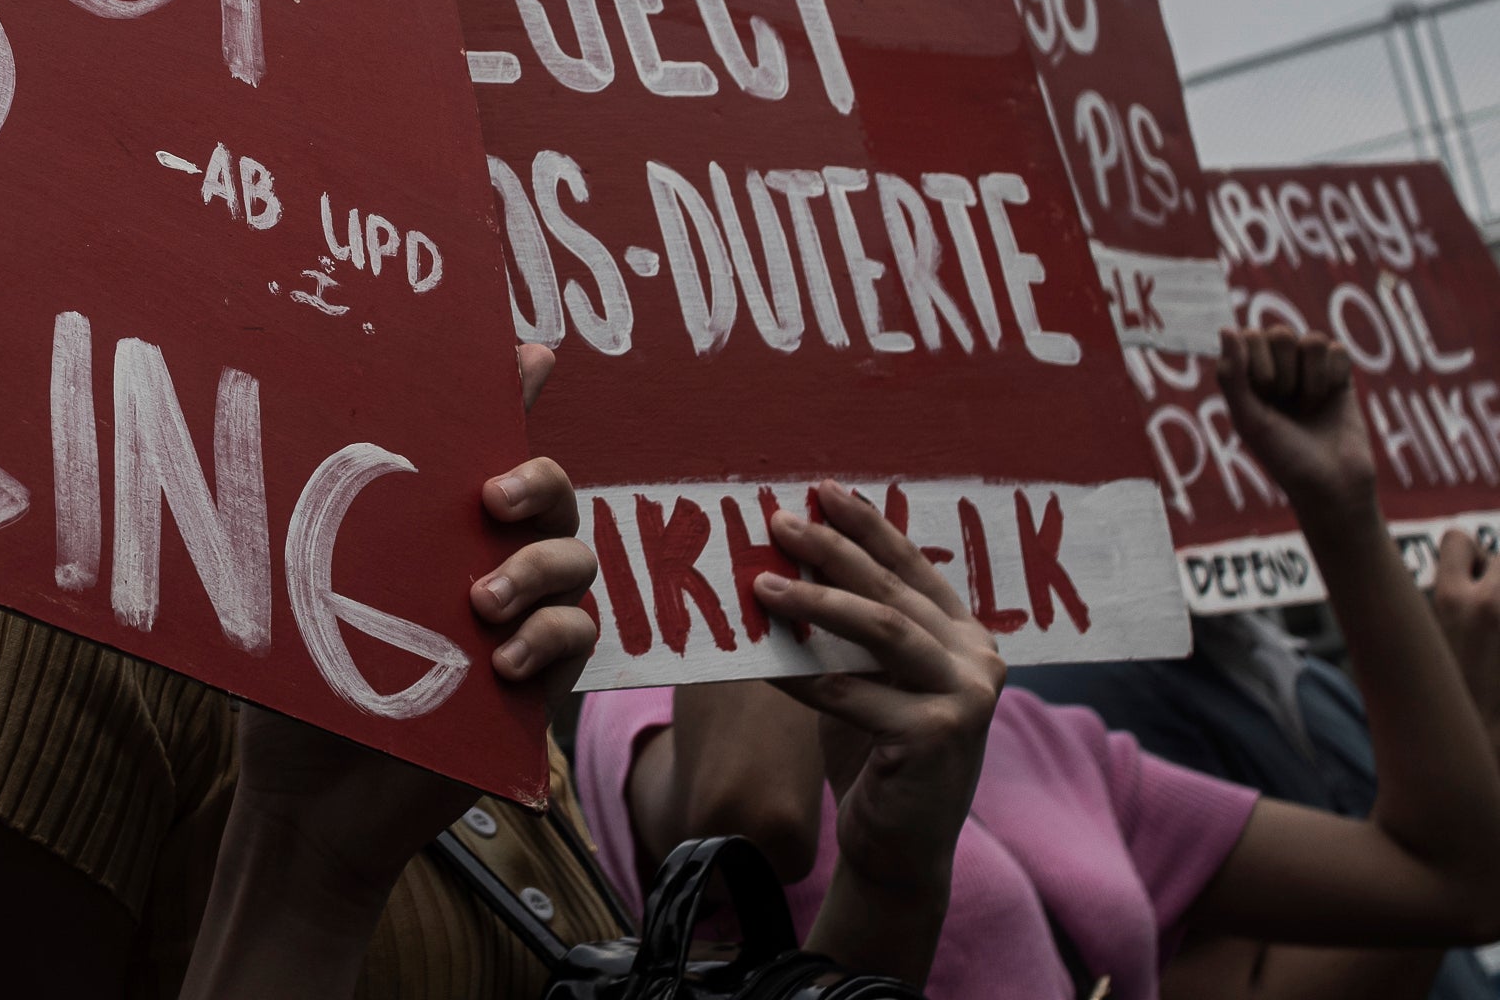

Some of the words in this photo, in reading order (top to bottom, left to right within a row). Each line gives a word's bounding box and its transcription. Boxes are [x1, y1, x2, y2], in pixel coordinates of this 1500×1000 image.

[320, 192, 443, 293] UPD
[1328, 270, 1475, 375] OIL
[1185, 549, 1310, 598] DEFEND
